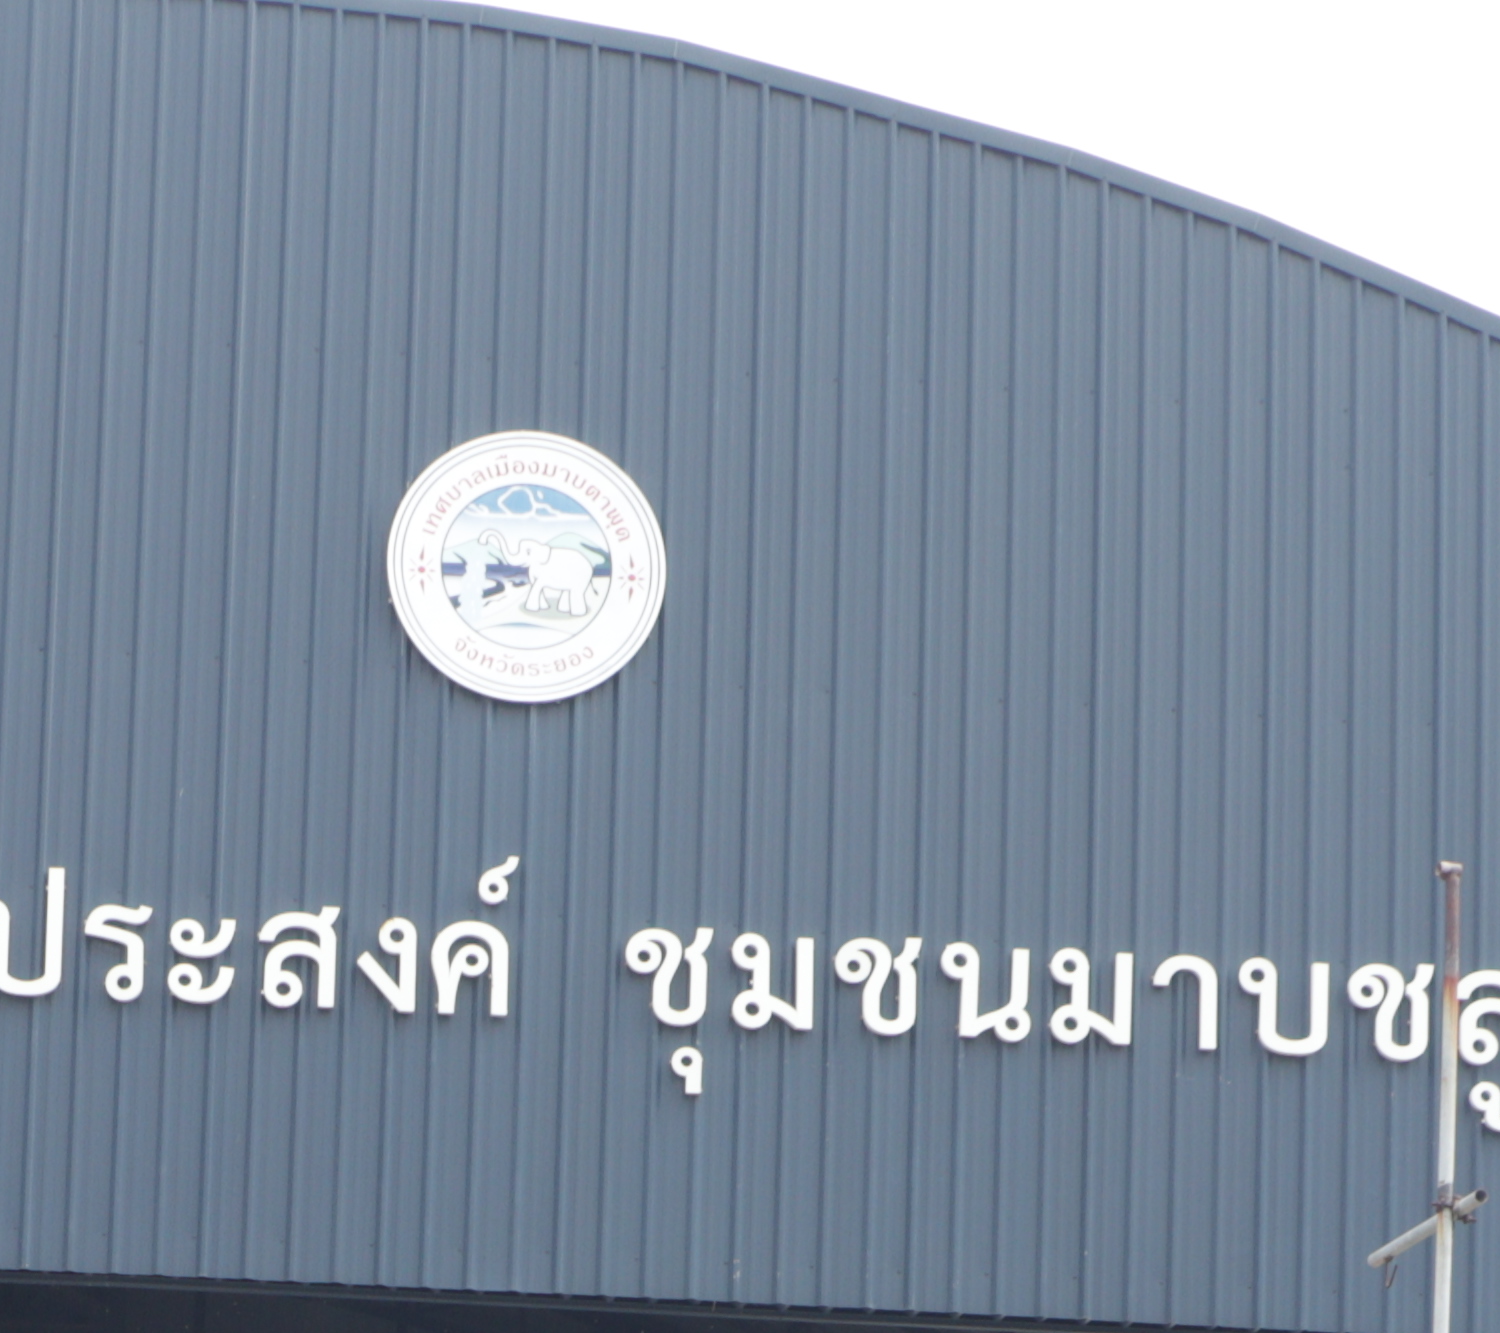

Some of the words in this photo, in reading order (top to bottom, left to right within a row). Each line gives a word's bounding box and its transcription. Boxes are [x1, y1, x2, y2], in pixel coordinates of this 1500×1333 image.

[454, 635, 595, 678] จังหวัดระยอง
